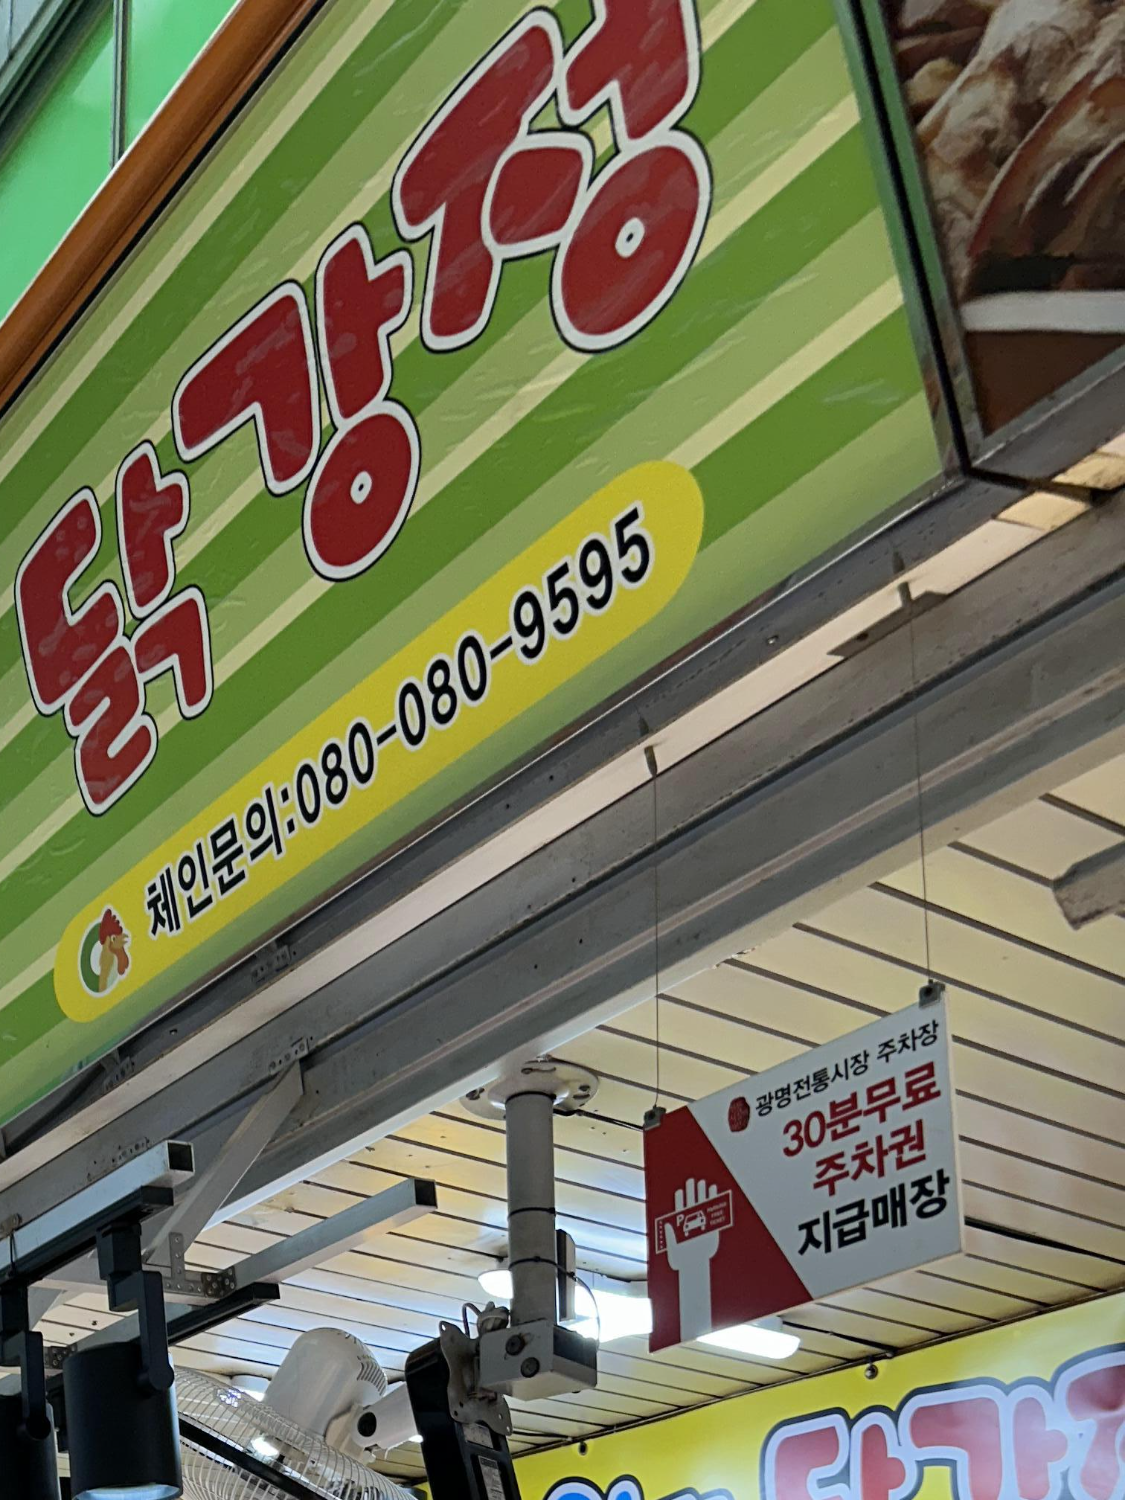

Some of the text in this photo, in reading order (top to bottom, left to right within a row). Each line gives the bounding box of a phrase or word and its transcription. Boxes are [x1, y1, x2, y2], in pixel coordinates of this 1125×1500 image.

[15, 0, 713, 816] 닭강정
[754, 1050, 870, 1117] 광명전통시장
[876, 1020, 940, 1065] 주차장
[781, 1061, 942, 1158] 30분무료
[812, 1119, 928, 1198] 주차권
[797, 1169, 951, 1256] 지급매장
